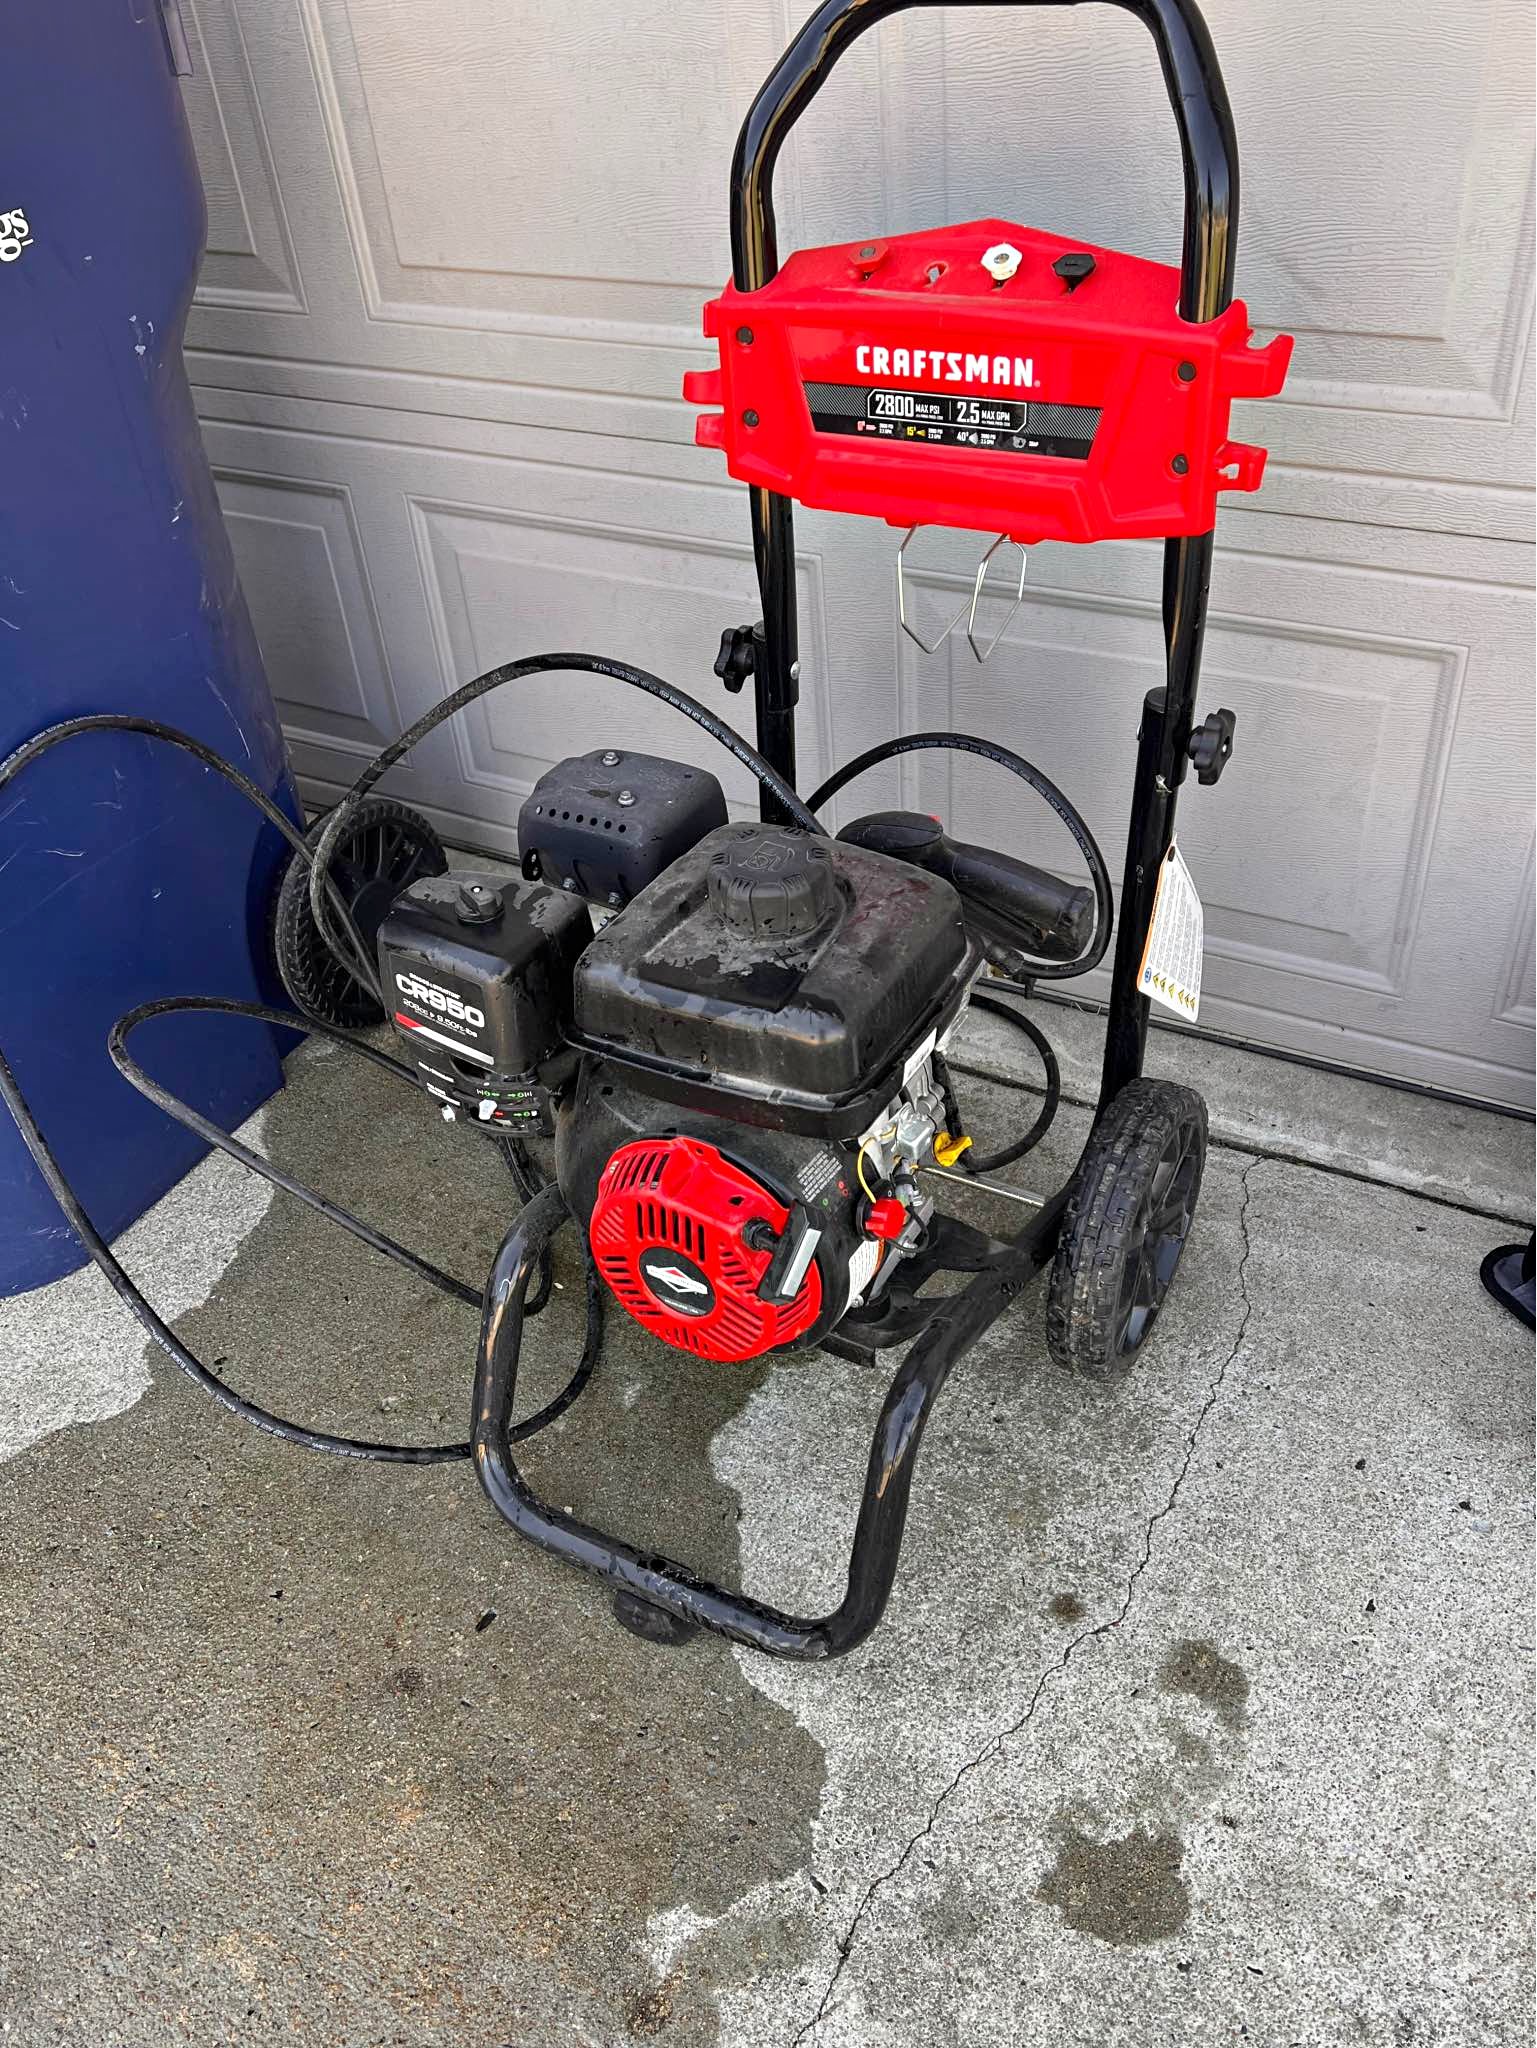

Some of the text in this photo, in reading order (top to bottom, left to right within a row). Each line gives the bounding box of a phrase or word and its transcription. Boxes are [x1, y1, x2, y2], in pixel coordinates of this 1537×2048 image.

[856, 345, 1034, 388] CRAFTSMAN
[875, 393, 914, 418] 2800
[916, 404, 928, 414] MAX
[929, 405, 940, 415] PSI
[957, 402, 979, 424] 2.5
[982, 410, 995, 420] MAX
[395, 973, 485, 1028] CR950
